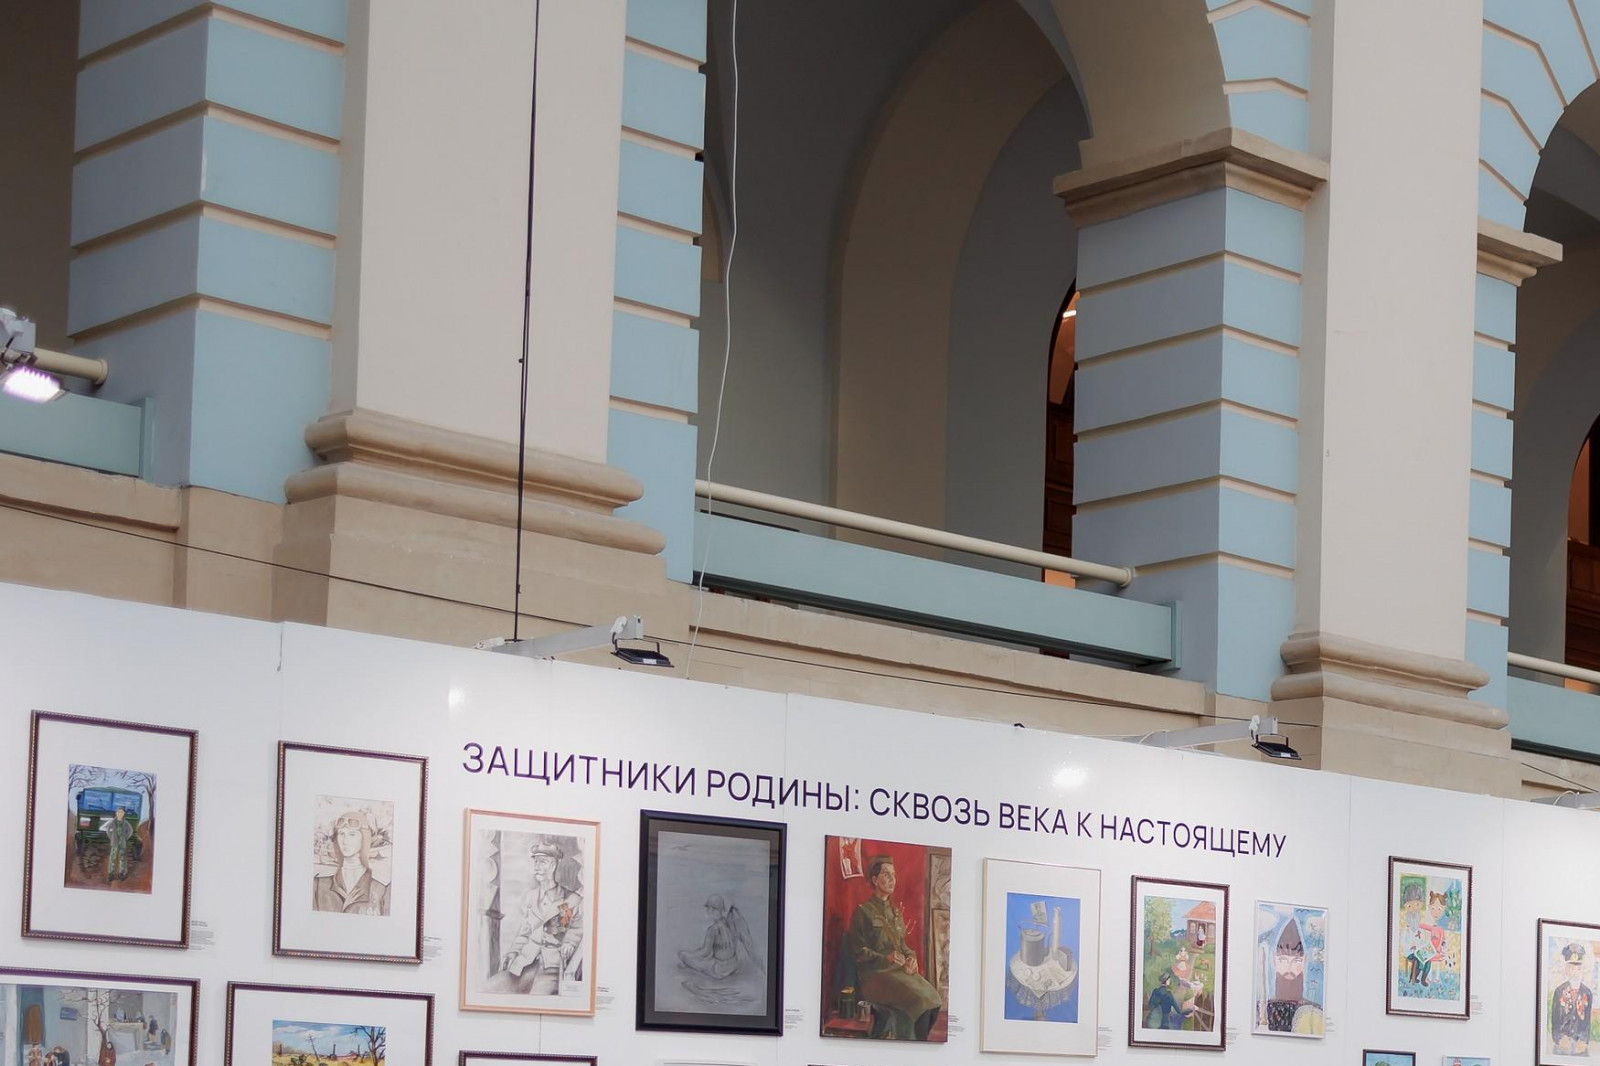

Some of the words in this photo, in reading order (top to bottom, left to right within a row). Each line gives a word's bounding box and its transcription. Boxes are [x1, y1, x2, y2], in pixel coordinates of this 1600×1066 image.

[462, 742, 696, 796] ЗАЩИТНИКИ
[707, 769, 860, 812] РОДИНЫ:
[870, 787, 990, 827] СКВОЗЬ
[999, 802, 1068, 836] ВЕКА
[1077, 811, 1093, 838] К
[1100, 815, 1287, 858] НАСТОЯЩЕМУ
